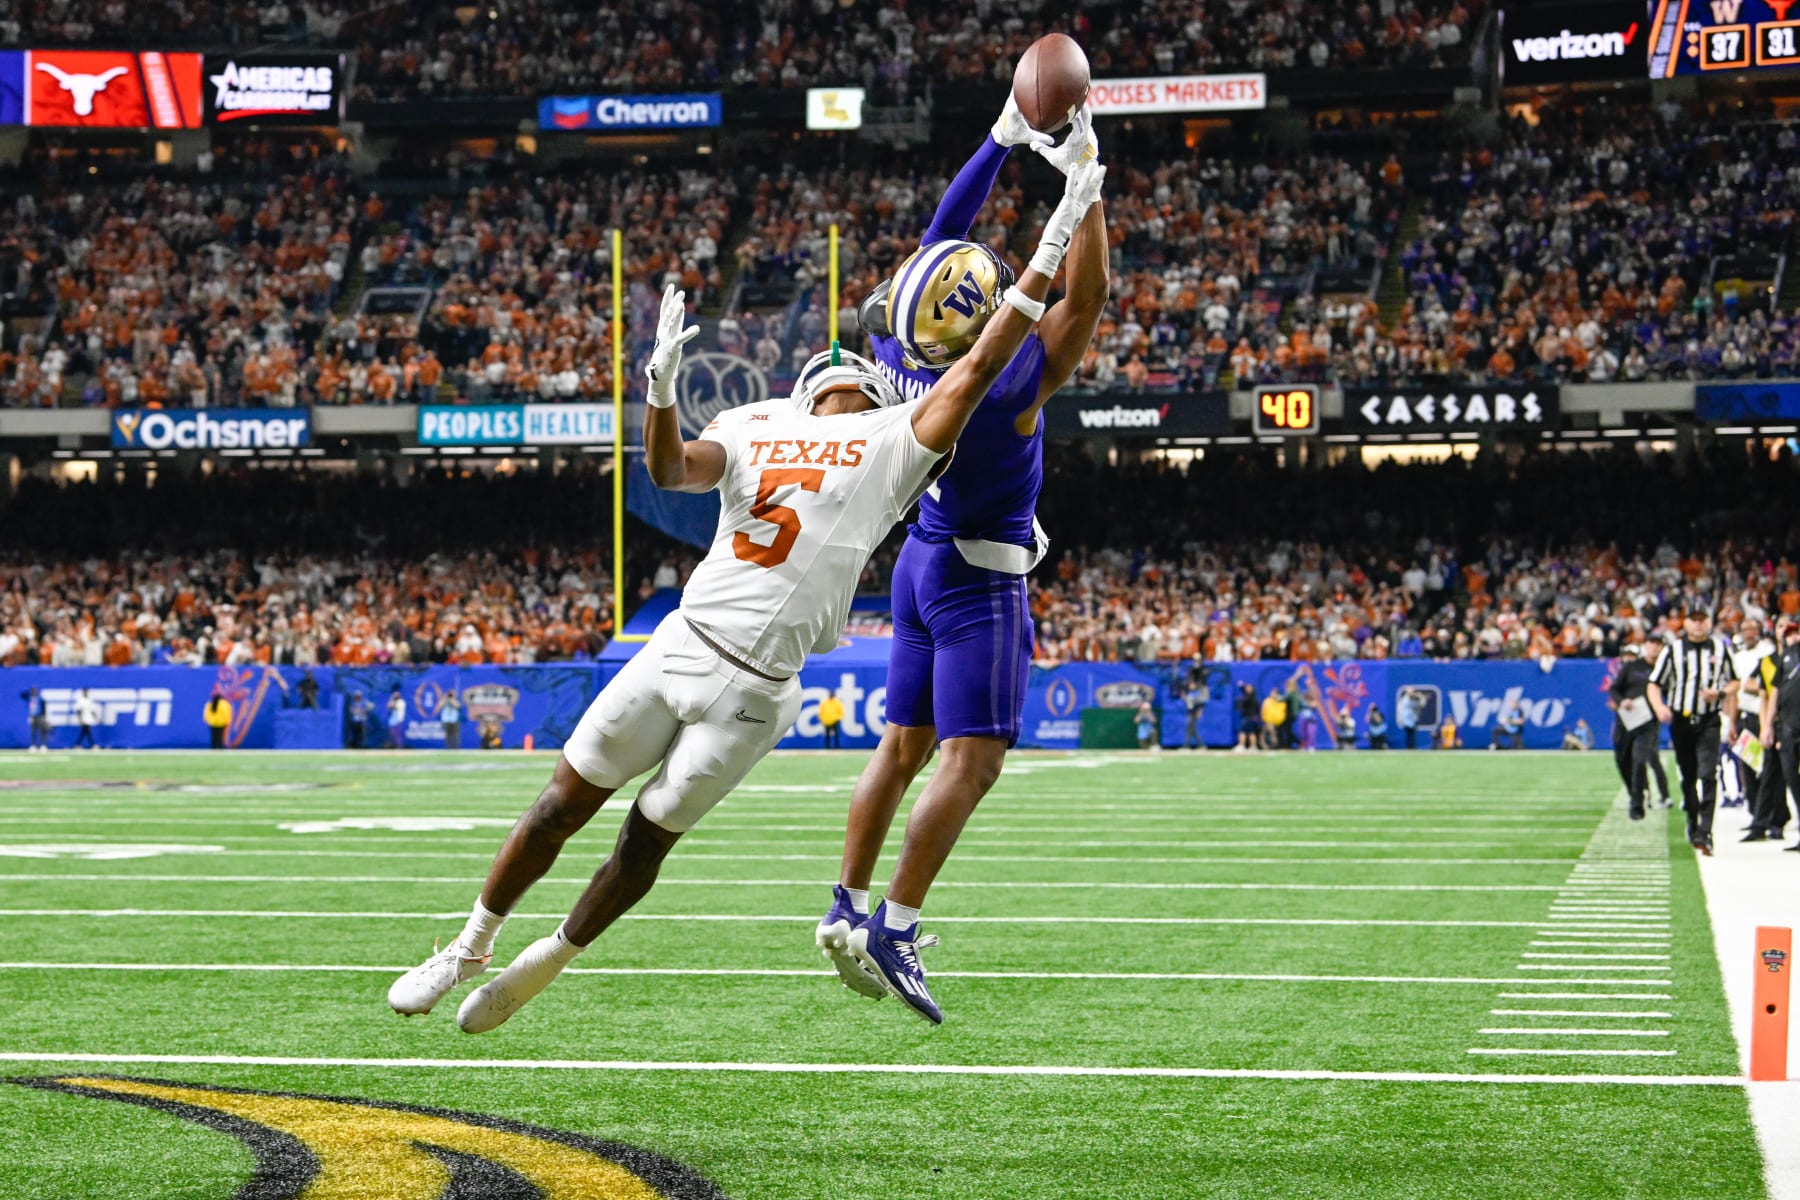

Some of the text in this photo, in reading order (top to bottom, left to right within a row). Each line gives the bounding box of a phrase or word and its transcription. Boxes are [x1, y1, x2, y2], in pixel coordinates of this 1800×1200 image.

[1513, 29, 1625, 62] verizon
[1711, 32, 1740, 61] 37
[1768, 27, 1796, 57] 31
[220, 63, 332, 91] AMERICAS
[1164, 80, 1259, 104] MARKETS
[597, 98, 709, 125] Chevron
[941, 269, 986, 319] W
[1079, 405, 1161, 428] verizon
[1262, 391, 1310, 428] 40
[1360, 392, 1542, 425] CAESARS
[140, 412, 306, 449] Ochsner
[422, 411, 612, 439] PEOPLES HEALTH
[750, 439, 867, 467] TEXAS
[732, 467, 826, 569] 5
[41, 688, 173, 726] ESPN
[1448, 686, 1566, 728] Vrbo
